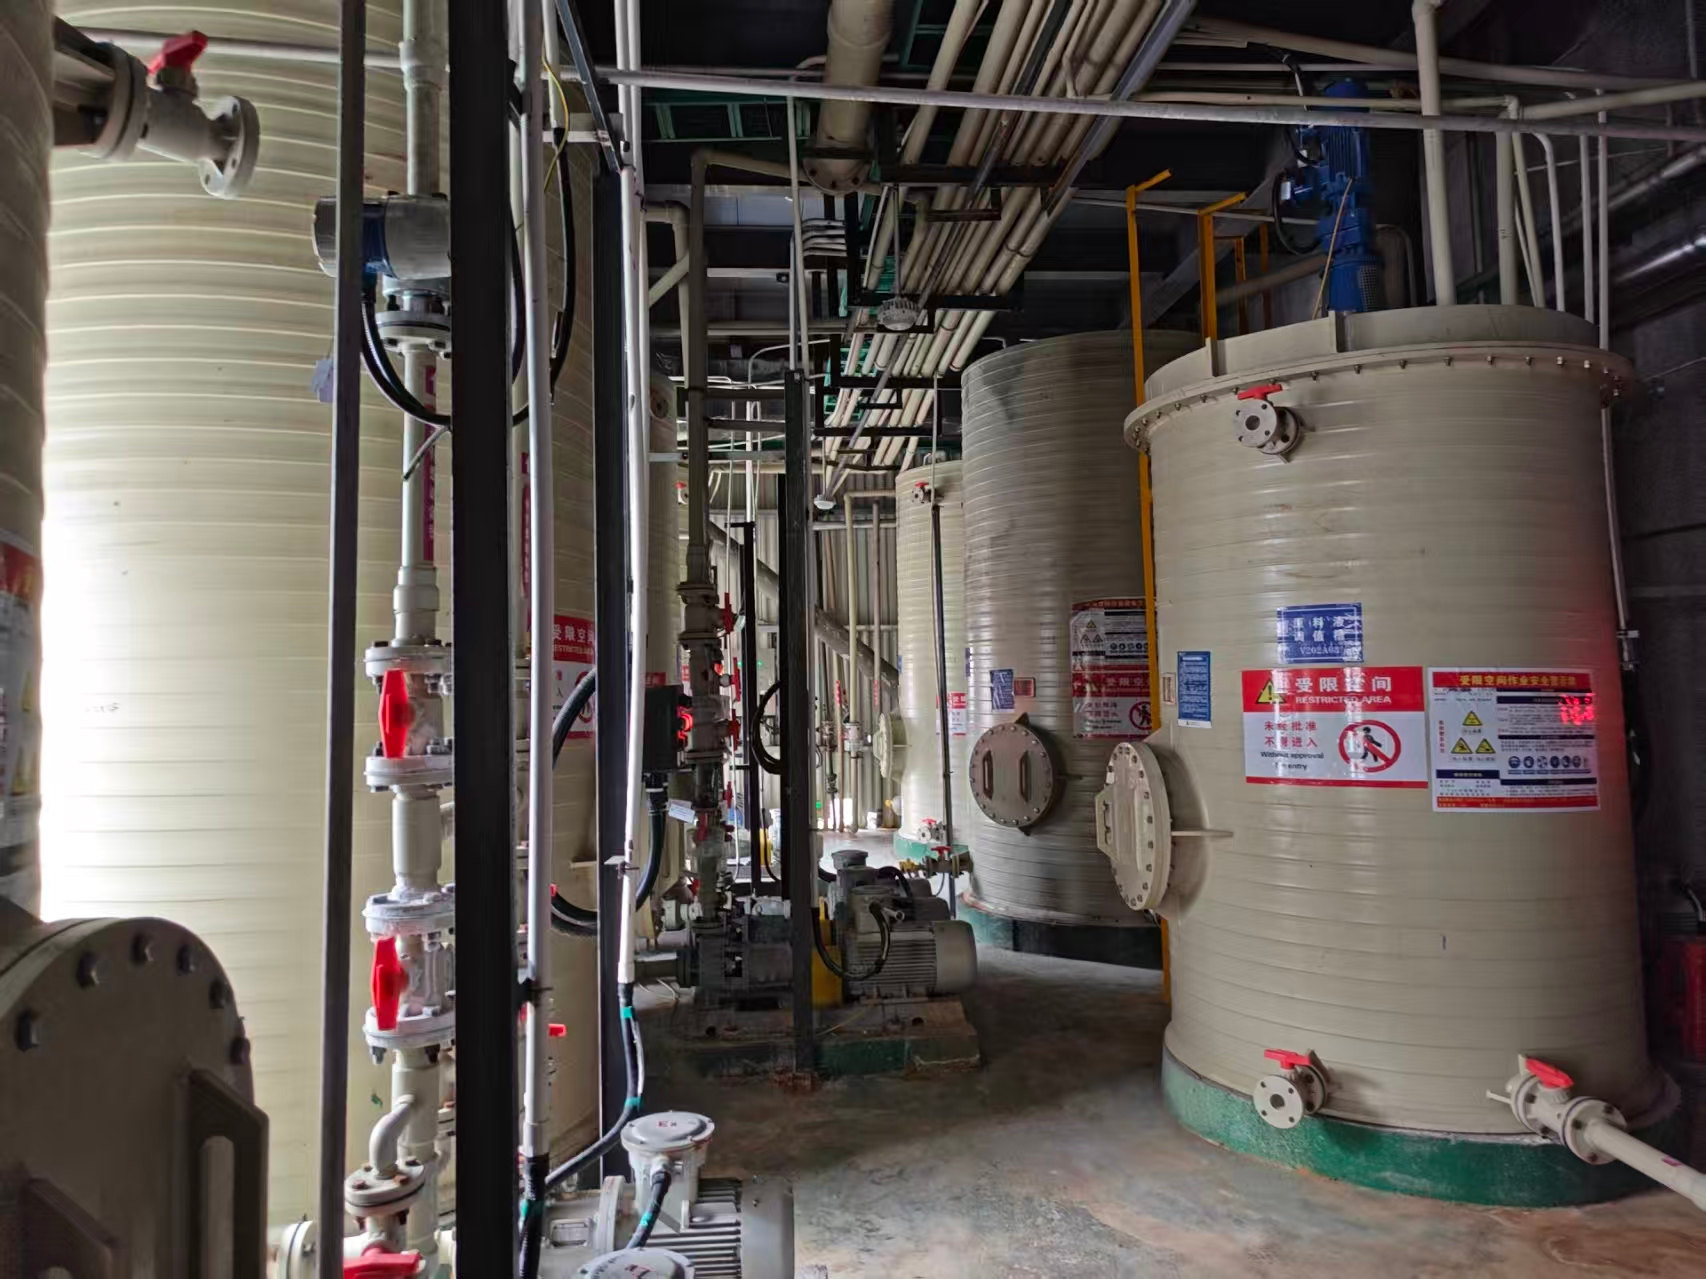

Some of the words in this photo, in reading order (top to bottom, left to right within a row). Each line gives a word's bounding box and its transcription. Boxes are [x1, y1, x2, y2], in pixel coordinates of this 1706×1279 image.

[1295, 676, 1392, 693] 受限空间
[1295, 695, 1361, 705] RESTRICTED
[1362, 695, 1392, 704] AREA
[1264, 721, 1318, 732] 未经批准
[1264, 736, 1318, 748] 不得进入
[1290, 752, 1325, 760] approval
[1287, 763, 1308, 771] entry
